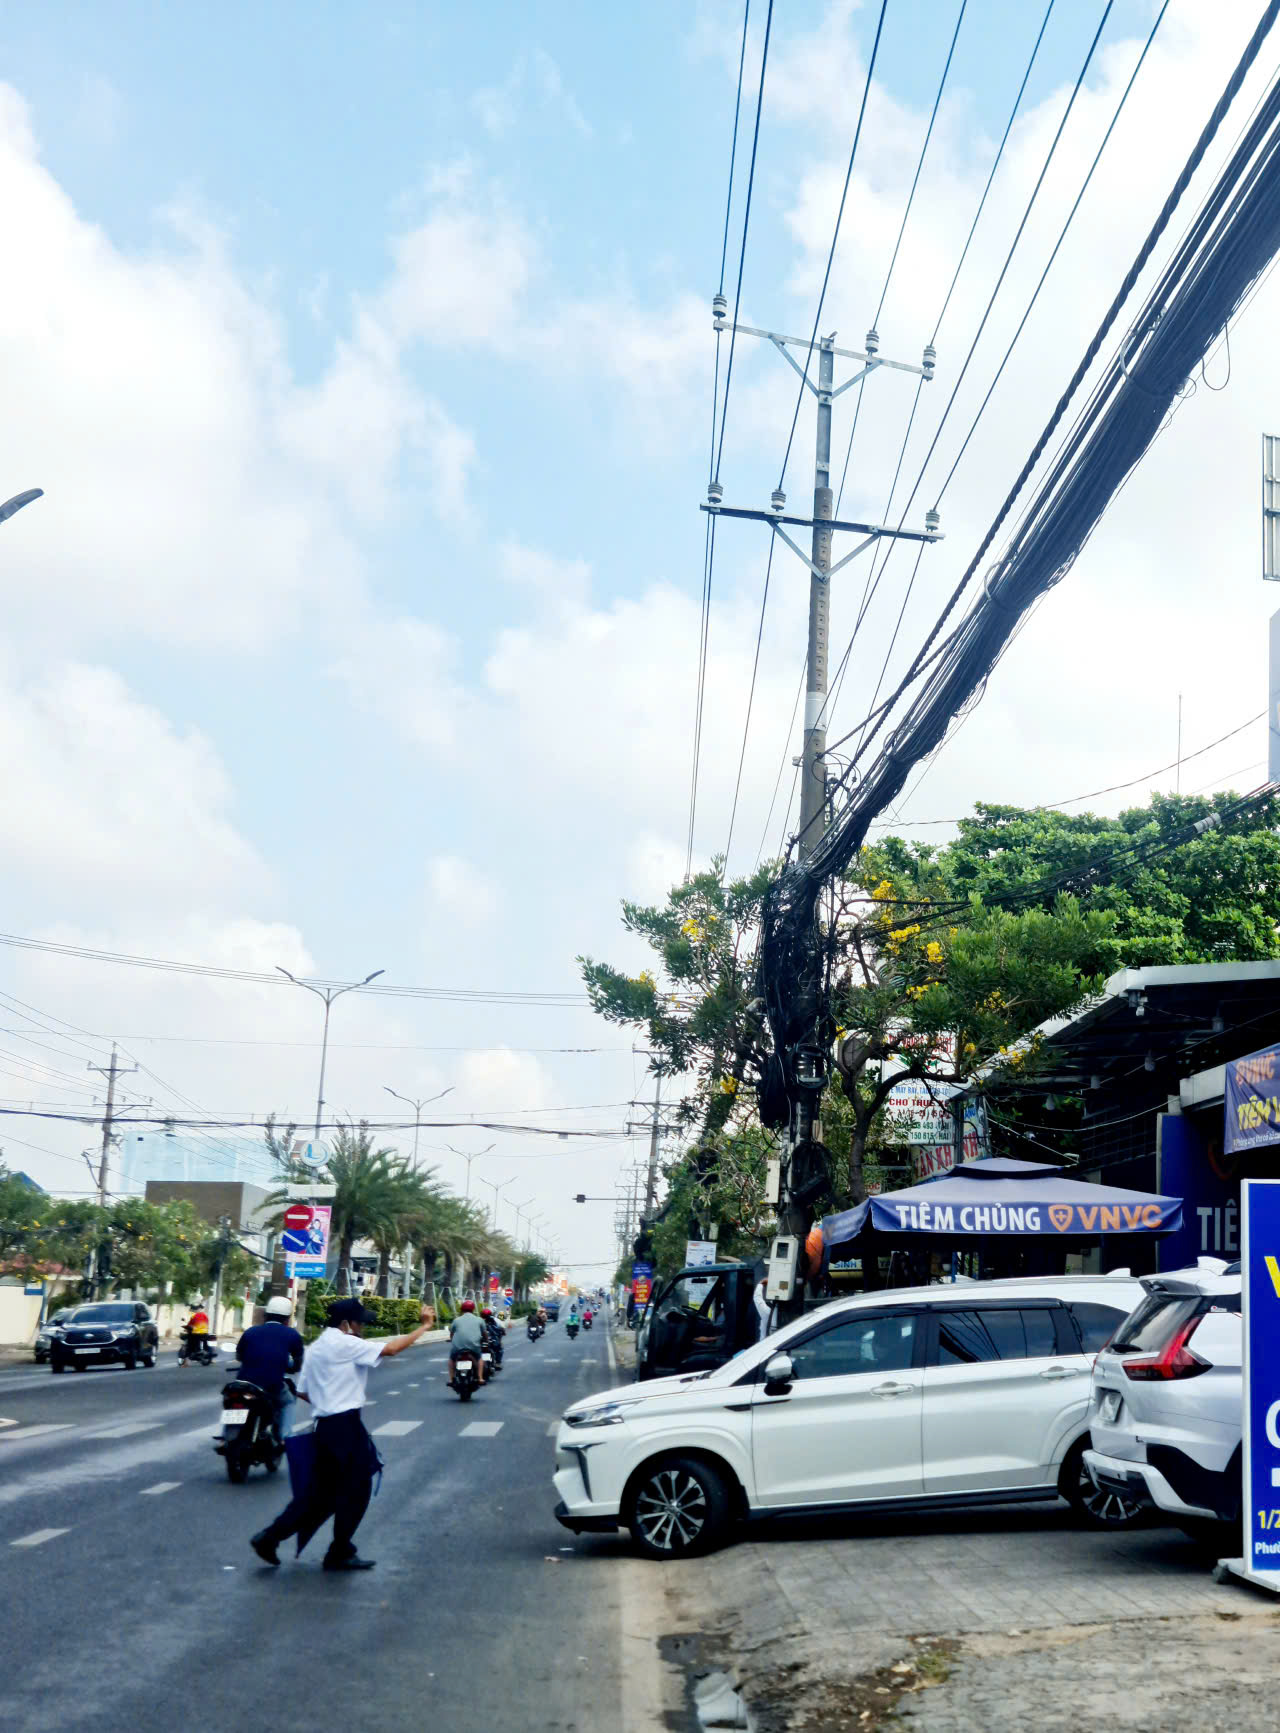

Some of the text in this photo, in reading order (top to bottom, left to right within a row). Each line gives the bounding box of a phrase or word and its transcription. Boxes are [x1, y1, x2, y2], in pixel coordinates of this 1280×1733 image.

[889, 1098, 908, 1106] CHO
[1237, 1094, 1271, 1131] TIÊM
[895, 1202, 1163, 1232] TIÊM CHỦNG VNVC
[1196, 1198, 1238, 1252] TIÊ
